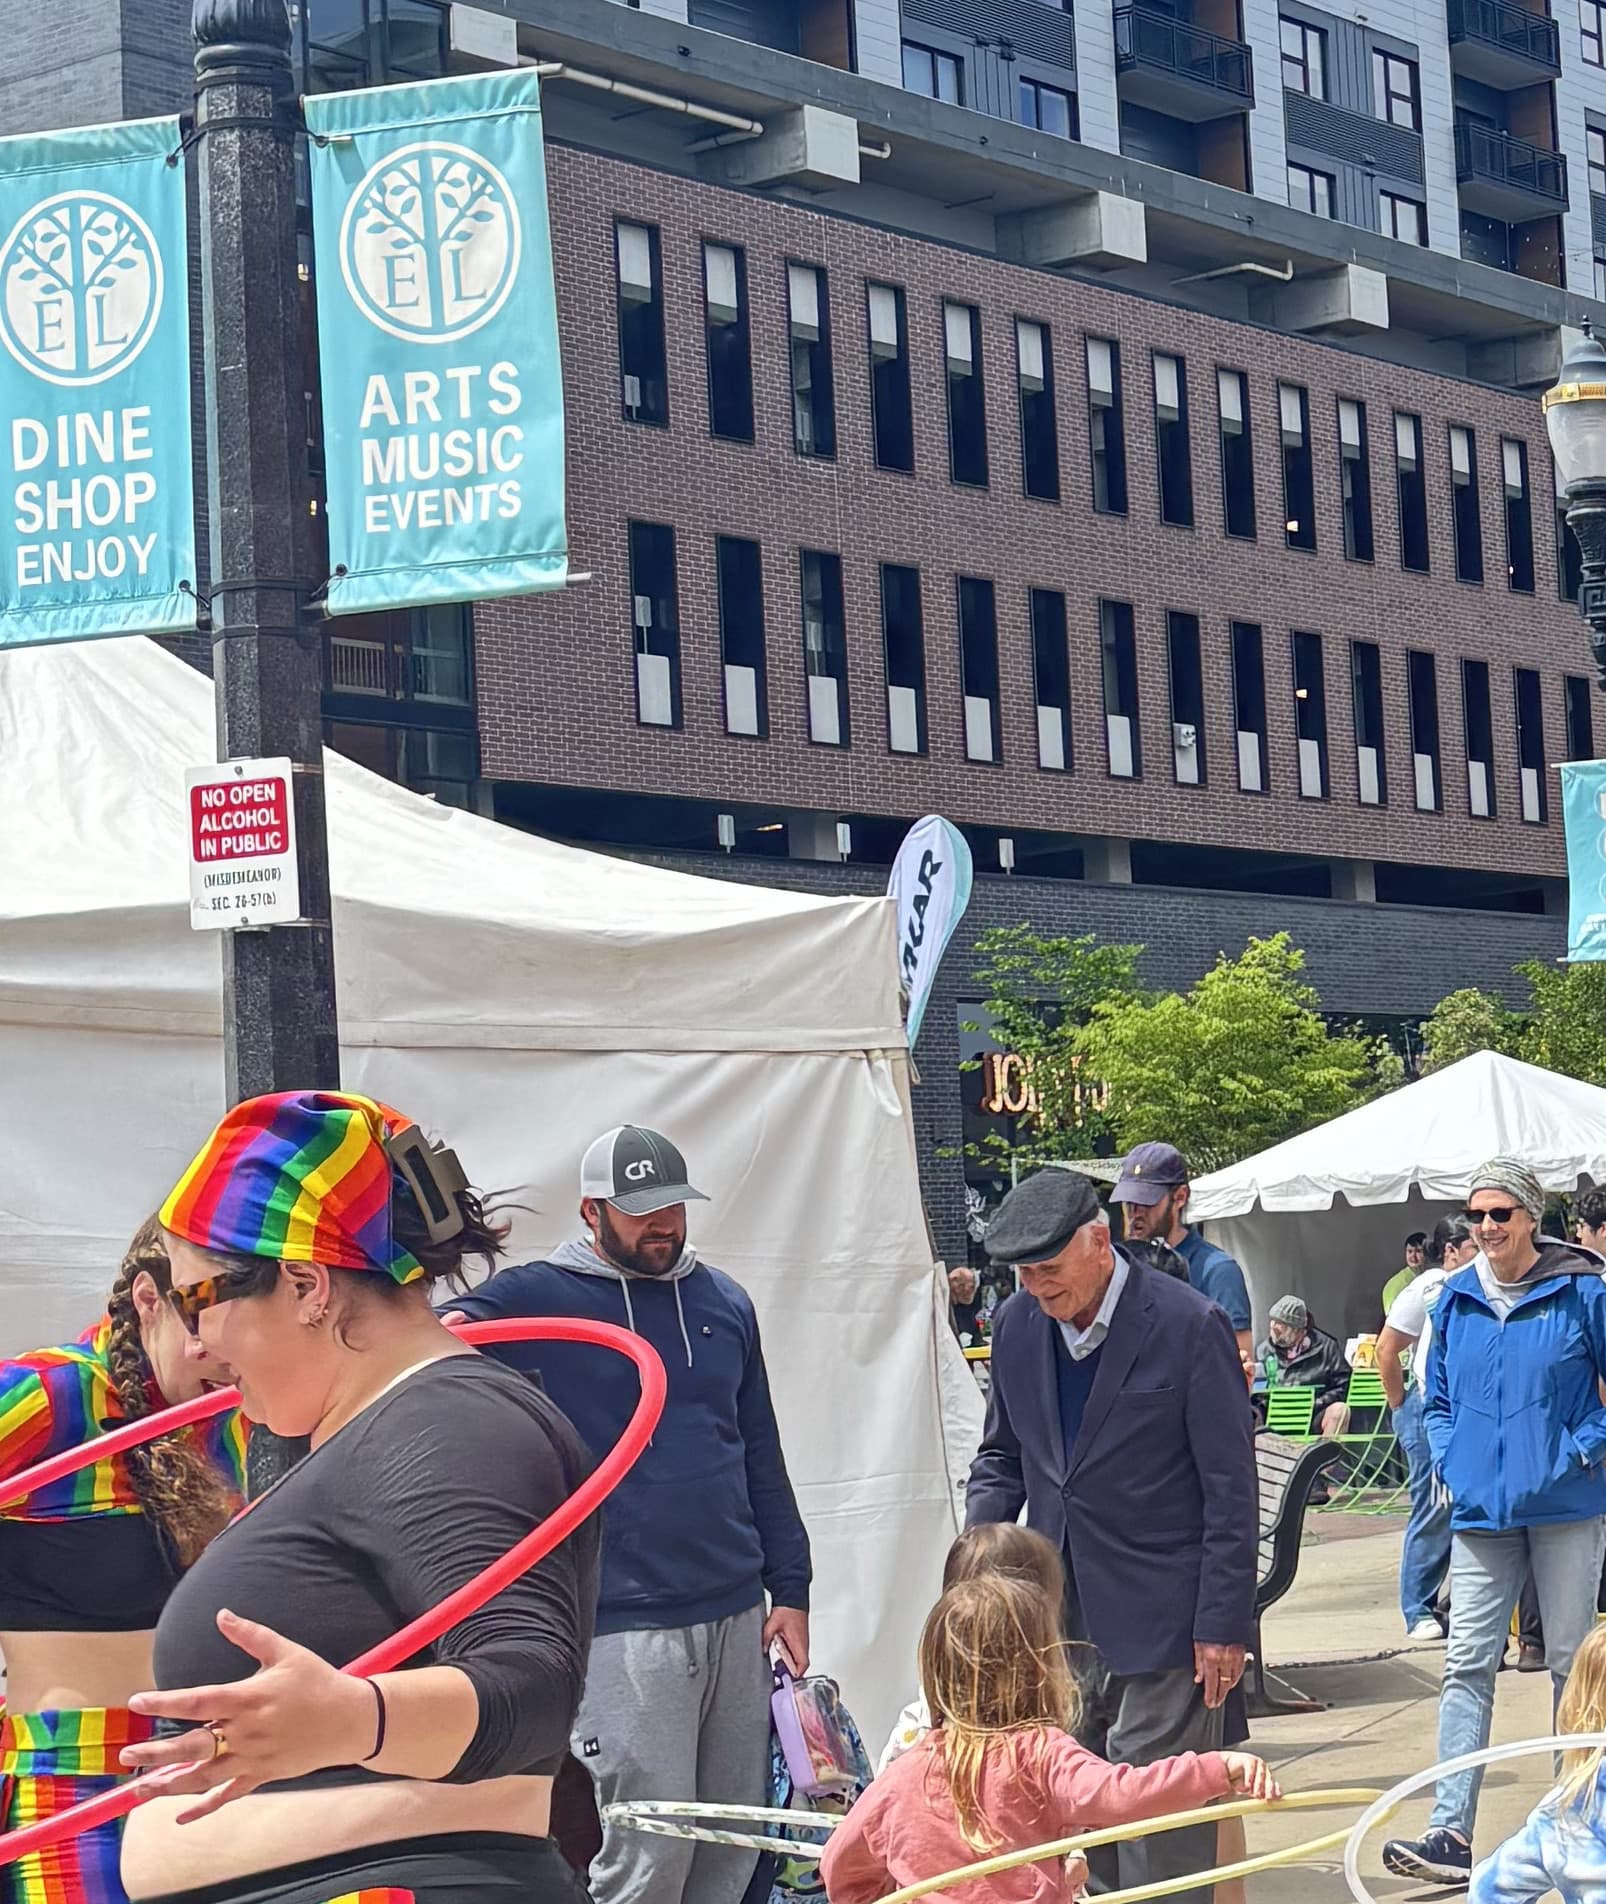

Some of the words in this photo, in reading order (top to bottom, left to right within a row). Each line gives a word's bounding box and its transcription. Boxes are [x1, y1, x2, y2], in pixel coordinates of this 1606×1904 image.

[359, 361, 522, 428] ARTS
[12, 405, 153, 471] DINE
[361, 424, 525, 486] MUSIC
[14, 471, 157, 534] SHOP
[364, 480, 523, 533] EVENTS
[16, 532, 158, 587] ENJOY
[200, 807, 281, 834] ALCOHOL
[201, 788, 226, 808] NO
[230, 782, 276, 805] OPEN
[200, 837, 217, 858] IN
[221, 831, 282, 856] PUBLIC
[624, 1159, 656, 1181] CR
